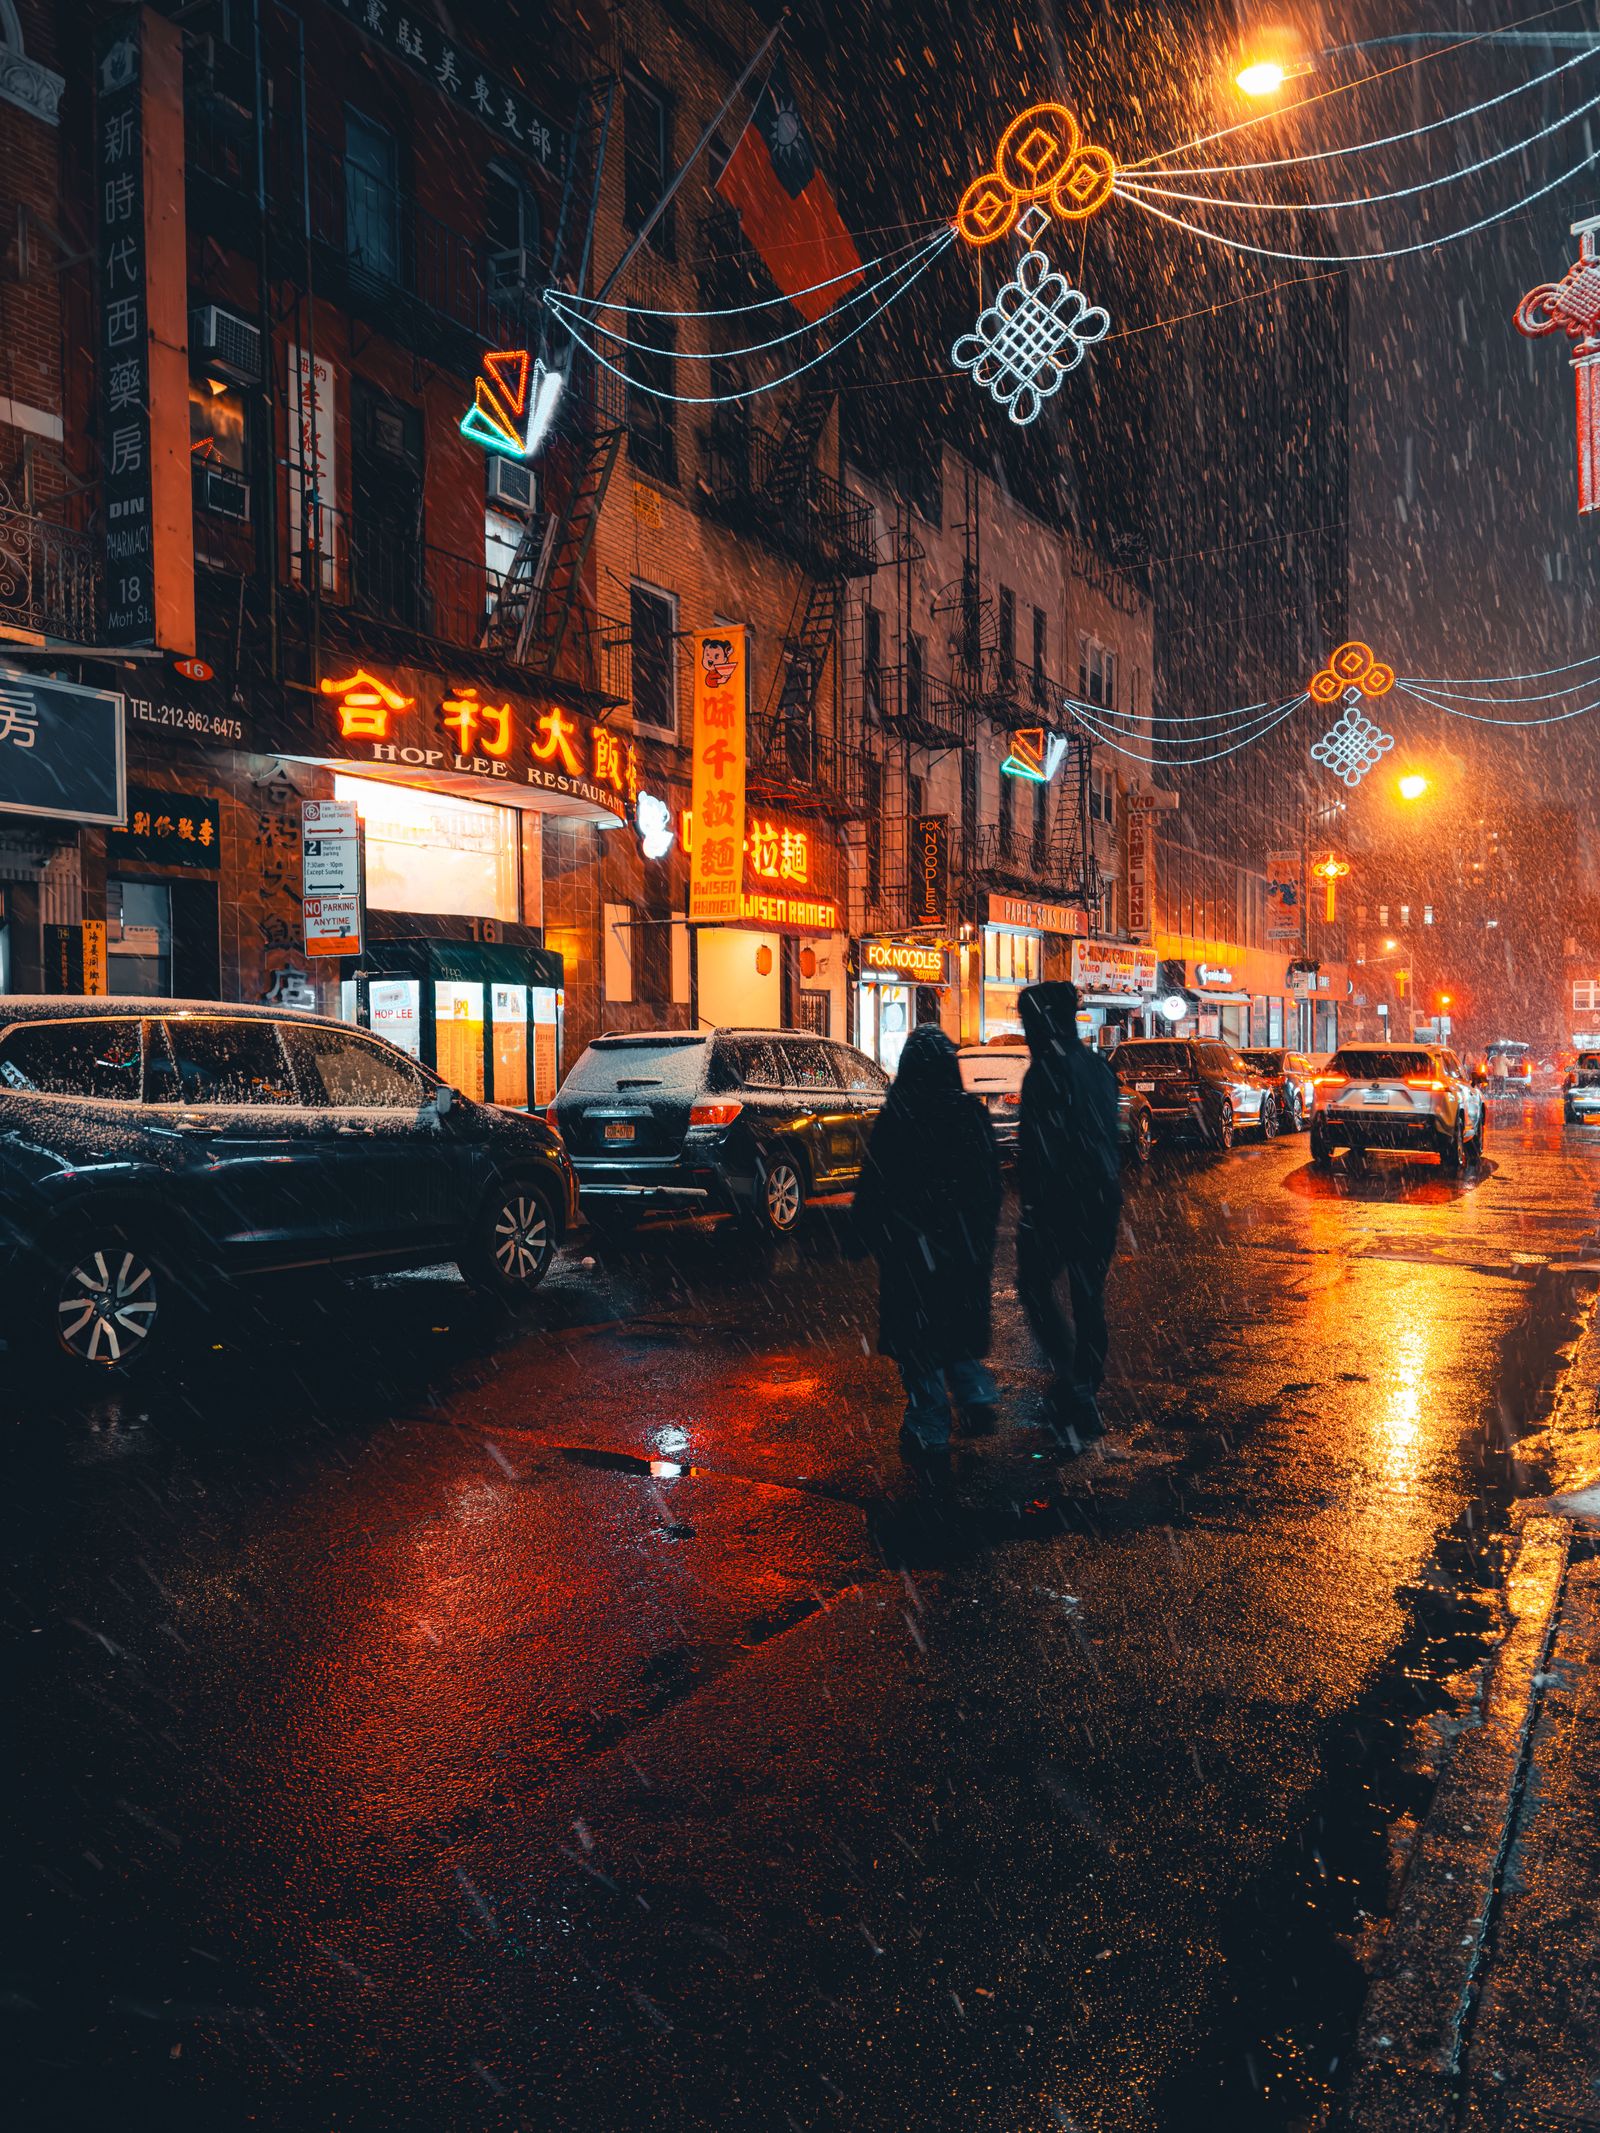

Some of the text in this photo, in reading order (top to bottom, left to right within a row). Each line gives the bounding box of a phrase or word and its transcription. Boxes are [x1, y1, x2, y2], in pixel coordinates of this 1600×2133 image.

[104, 108, 142, 475] 新時代西藥房
[109, 497, 145, 519] DIN
[106, 525, 150, 560] PHARMACY
[119, 576, 141, 604] 18
[108, 610, 134, 629] Mott
[182, 662, 204, 679] 16
[130, 698, 242, 740] TEL:212-962-6475
[321, 669, 637, 803] 合利大飯店
[372, 743, 626, 813] HOP LEE RESTAURANT
[700, 690, 737, 877] 味千拉麵
[919, 821, 941, 831] FOK
[308, 841, 317, 855] 2
[306, 868, 344, 876] Except Sunday
[924, 833, 938, 914] NOODLES
[693, 880, 737, 895] AJISEN
[305, 902, 355, 915] NO PARKING
[788, 900, 835, 929] RAMEN
[1005, 900, 1032, 923] PAPER
[313, 917, 351, 926] ANYTIME
[468, 918, 497, 942] 16
[868, 946, 942, 970] FOK NOODLES
[1080, 963, 1100, 973] VIDEO
[374, 1009, 414, 1019] HOP LEE
